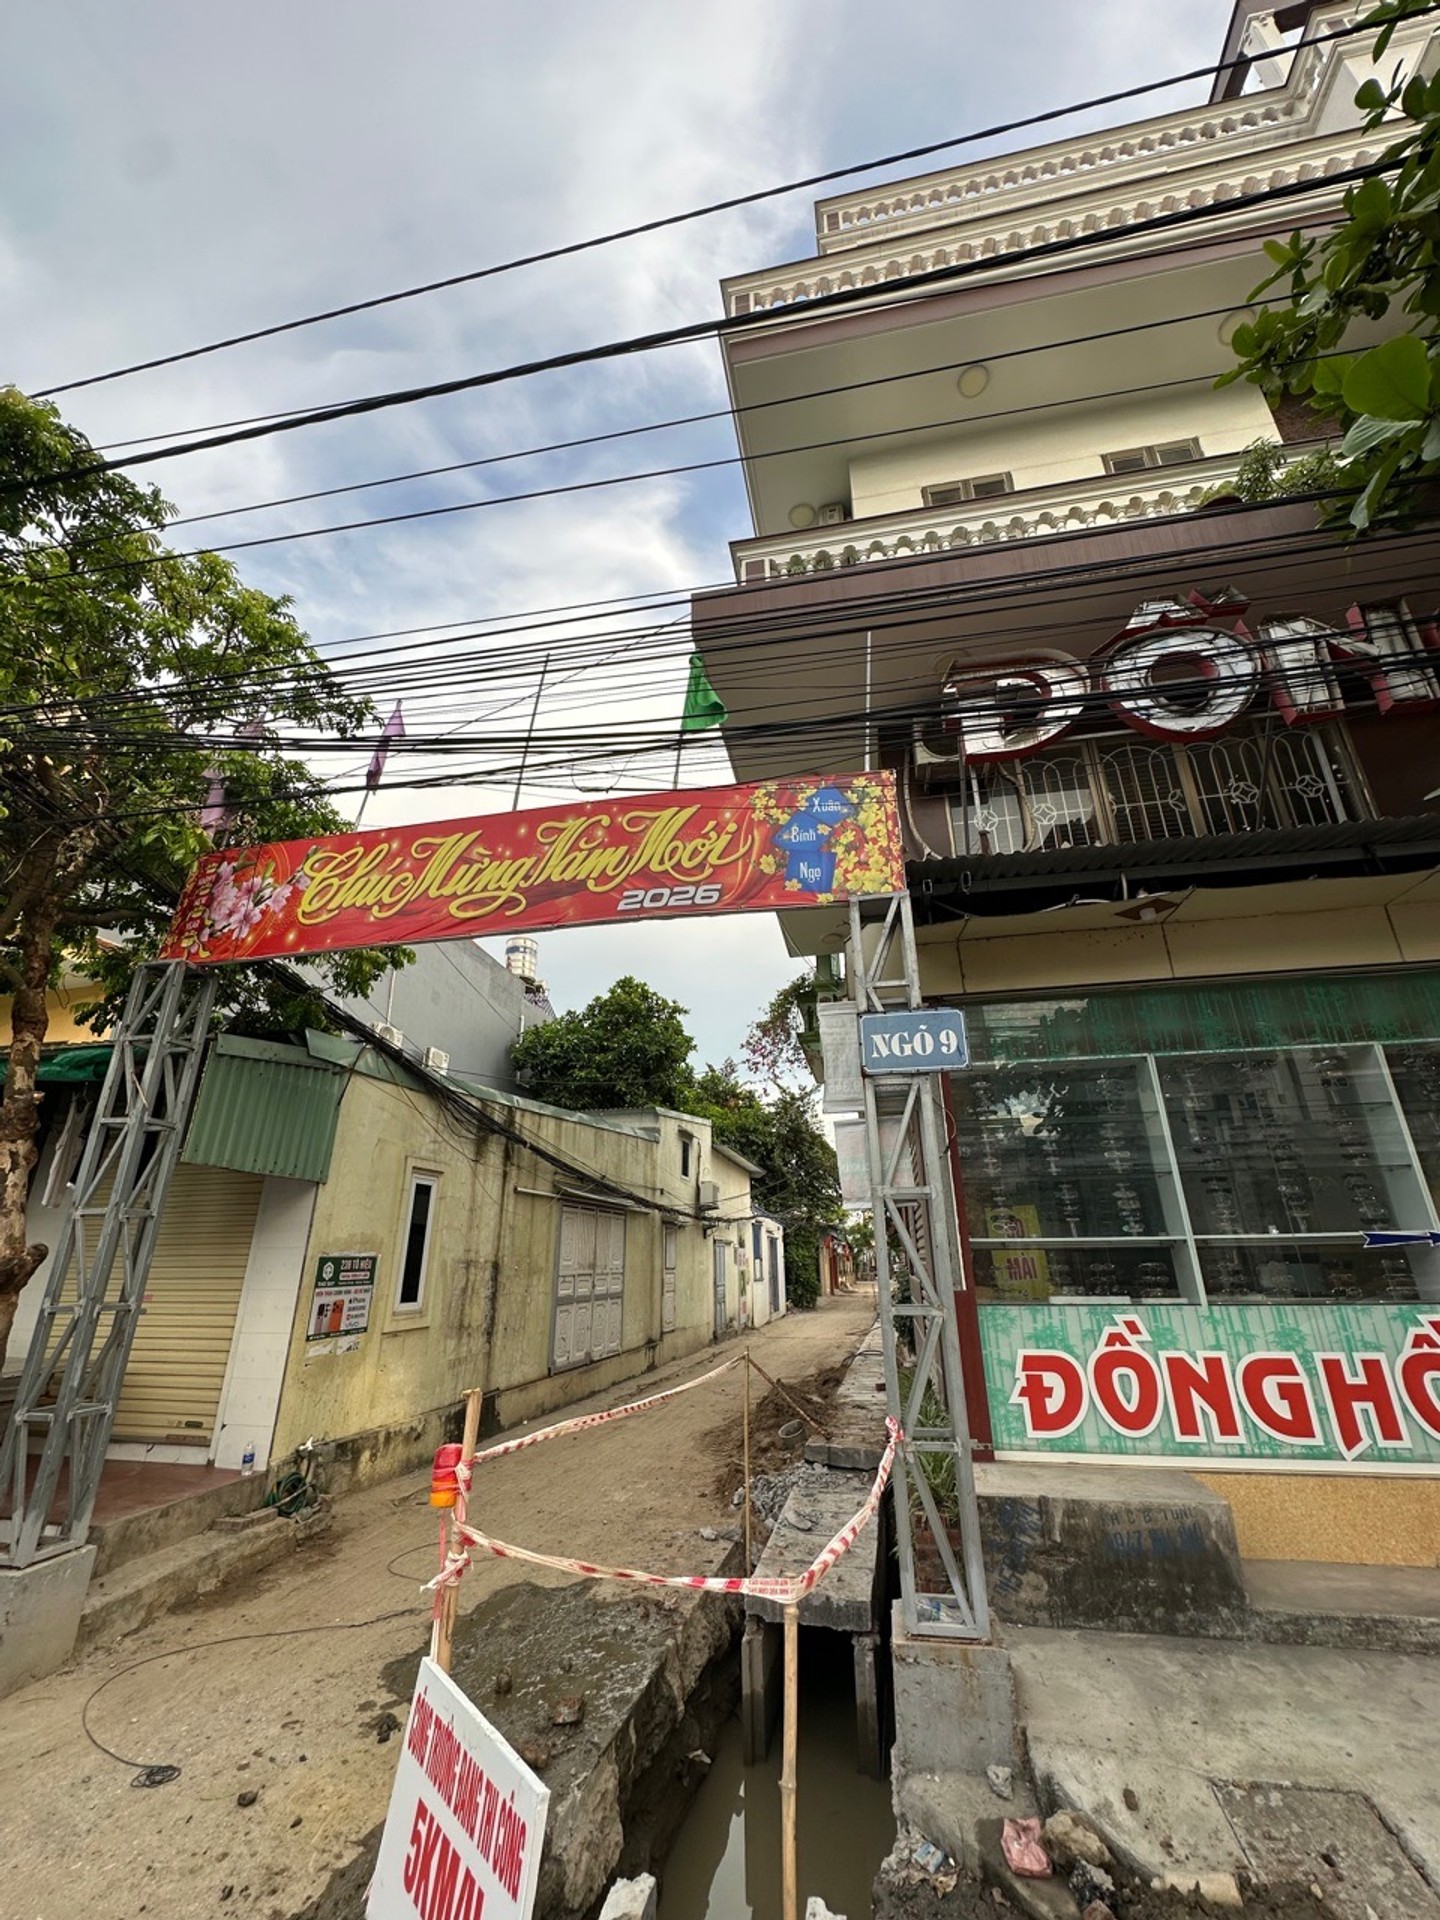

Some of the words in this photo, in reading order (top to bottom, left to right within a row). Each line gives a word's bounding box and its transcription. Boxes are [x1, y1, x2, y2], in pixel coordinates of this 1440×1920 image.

[812, 797, 842, 812] Xuân
[799, 862, 822, 883] Ngọ
[617, 883, 723, 911] 2026
[870, 1024, 934, 1058] NGÕ
[938, 1029, 958, 1055] 9
